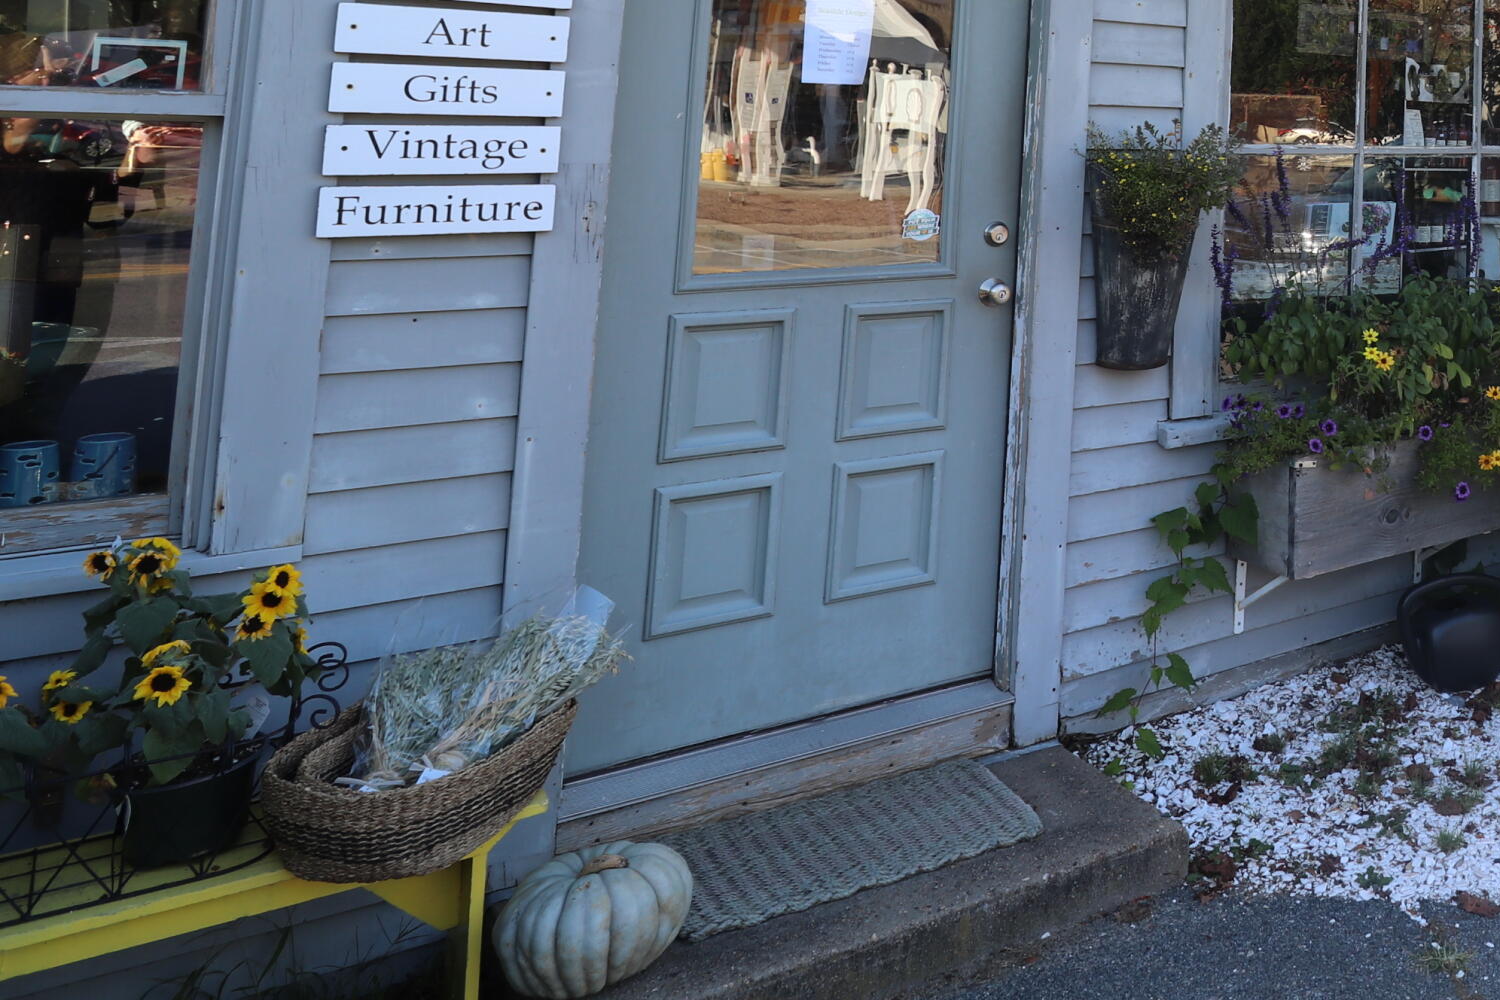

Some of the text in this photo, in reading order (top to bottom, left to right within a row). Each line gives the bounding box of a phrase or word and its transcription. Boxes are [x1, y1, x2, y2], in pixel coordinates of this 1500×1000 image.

[422, 18, 492, 48] Art
[403, 74, 498, 104] Gifts
[365, 129, 529, 169] Vintage
[331, 191, 544, 227] Furniture
